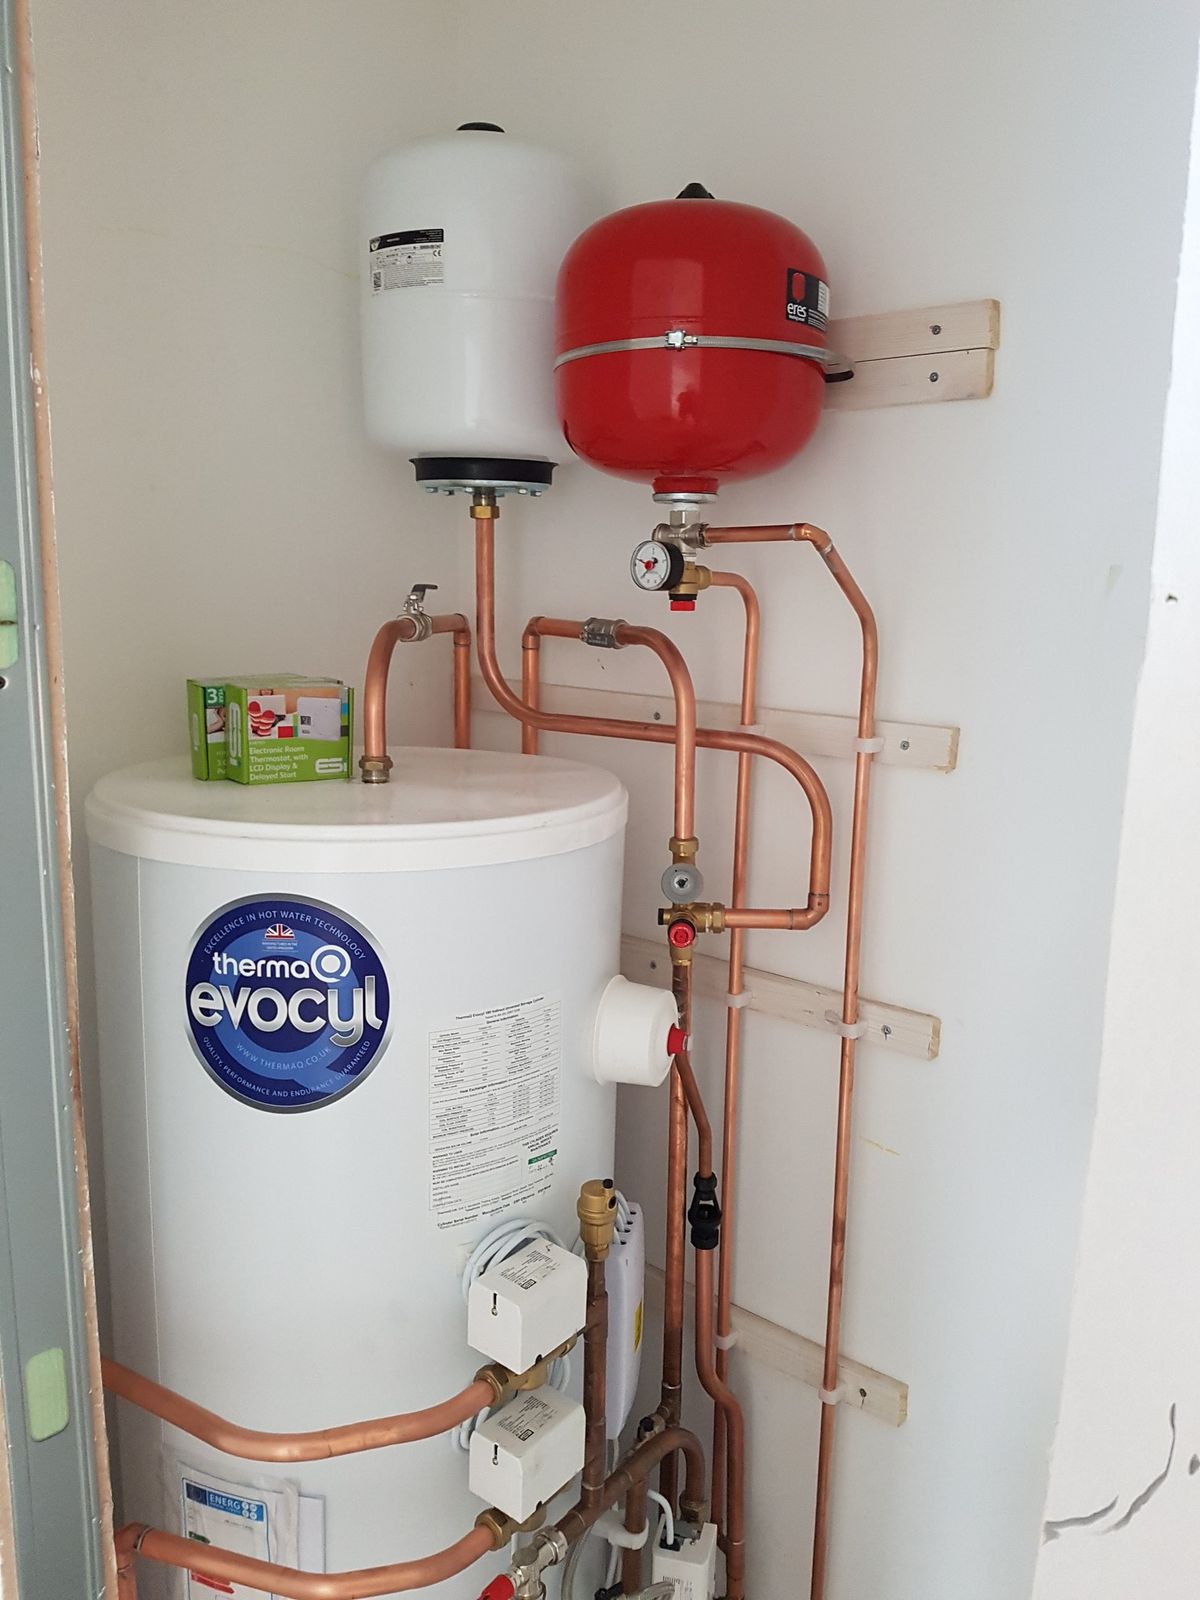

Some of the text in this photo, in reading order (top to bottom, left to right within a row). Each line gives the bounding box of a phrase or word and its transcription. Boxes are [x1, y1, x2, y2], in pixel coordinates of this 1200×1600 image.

[787, 303, 807, 318] eres
[207, 688, 218, 704] 3
[249, 745, 305, 755] Electronic Room
[249, 764, 264, 772] LCD
[266, 763, 291, 772] Display
[249, 771, 297, 781] Delayed Start
[203, 910, 367, 960] EXCELLENCE IN HOT WATER TECHNOLOGY
[190, 975, 383, 1048] evocyl
[203, 1036, 371, 1098] QUALITY, PERFORMANCE AND ENDURANCE GUARANTEED
[209, 1493, 241, 1510] ENERG
